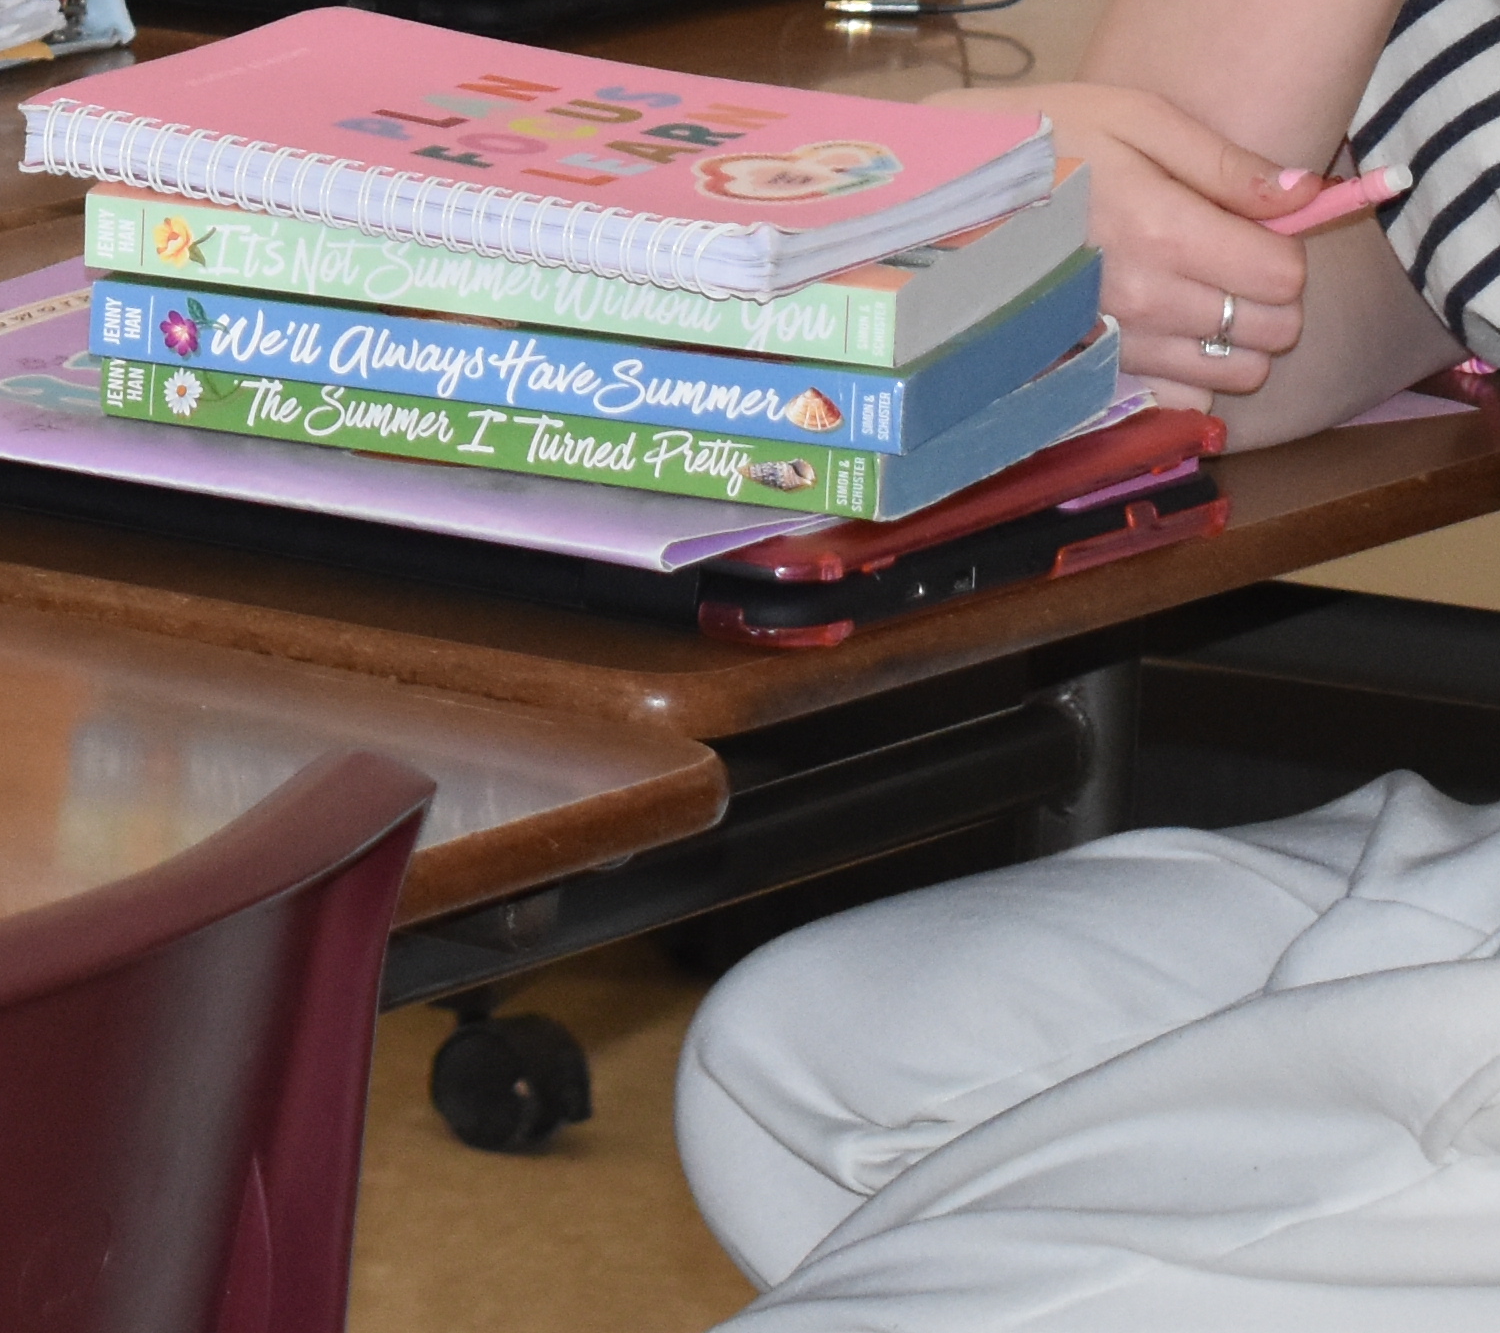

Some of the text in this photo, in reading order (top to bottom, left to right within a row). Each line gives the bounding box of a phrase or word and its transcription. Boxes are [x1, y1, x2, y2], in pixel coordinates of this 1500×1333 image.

[332, 74, 561, 141] PLAN
[411, 86, 682, 169] FOCUS
[521, 103, 789, 187] LEARN
[97, 208, 116, 259] JENNY
[119, 218, 136, 253] HAN
[197, 221, 285, 278] It's
[291, 226, 386, 296] Not
[363, 236, 550, 303] Summer
[104, 296, 122, 345] JENNY
[124, 307, 142, 339] HAN
[107, 359, 127, 408] JENNY
[127, 367, 145, 401] HAN
[211, 309, 790, 422] We'll Always Have Summer
[238, 379, 754, 498] The Summer I Turned Pretty
[861, 407, 875, 435] SIMON
[877, 391, 892, 441] SCHUSTER
[837, 460, 850, 505] SIMON &
[852, 457, 865, 512] SCHUSTER
